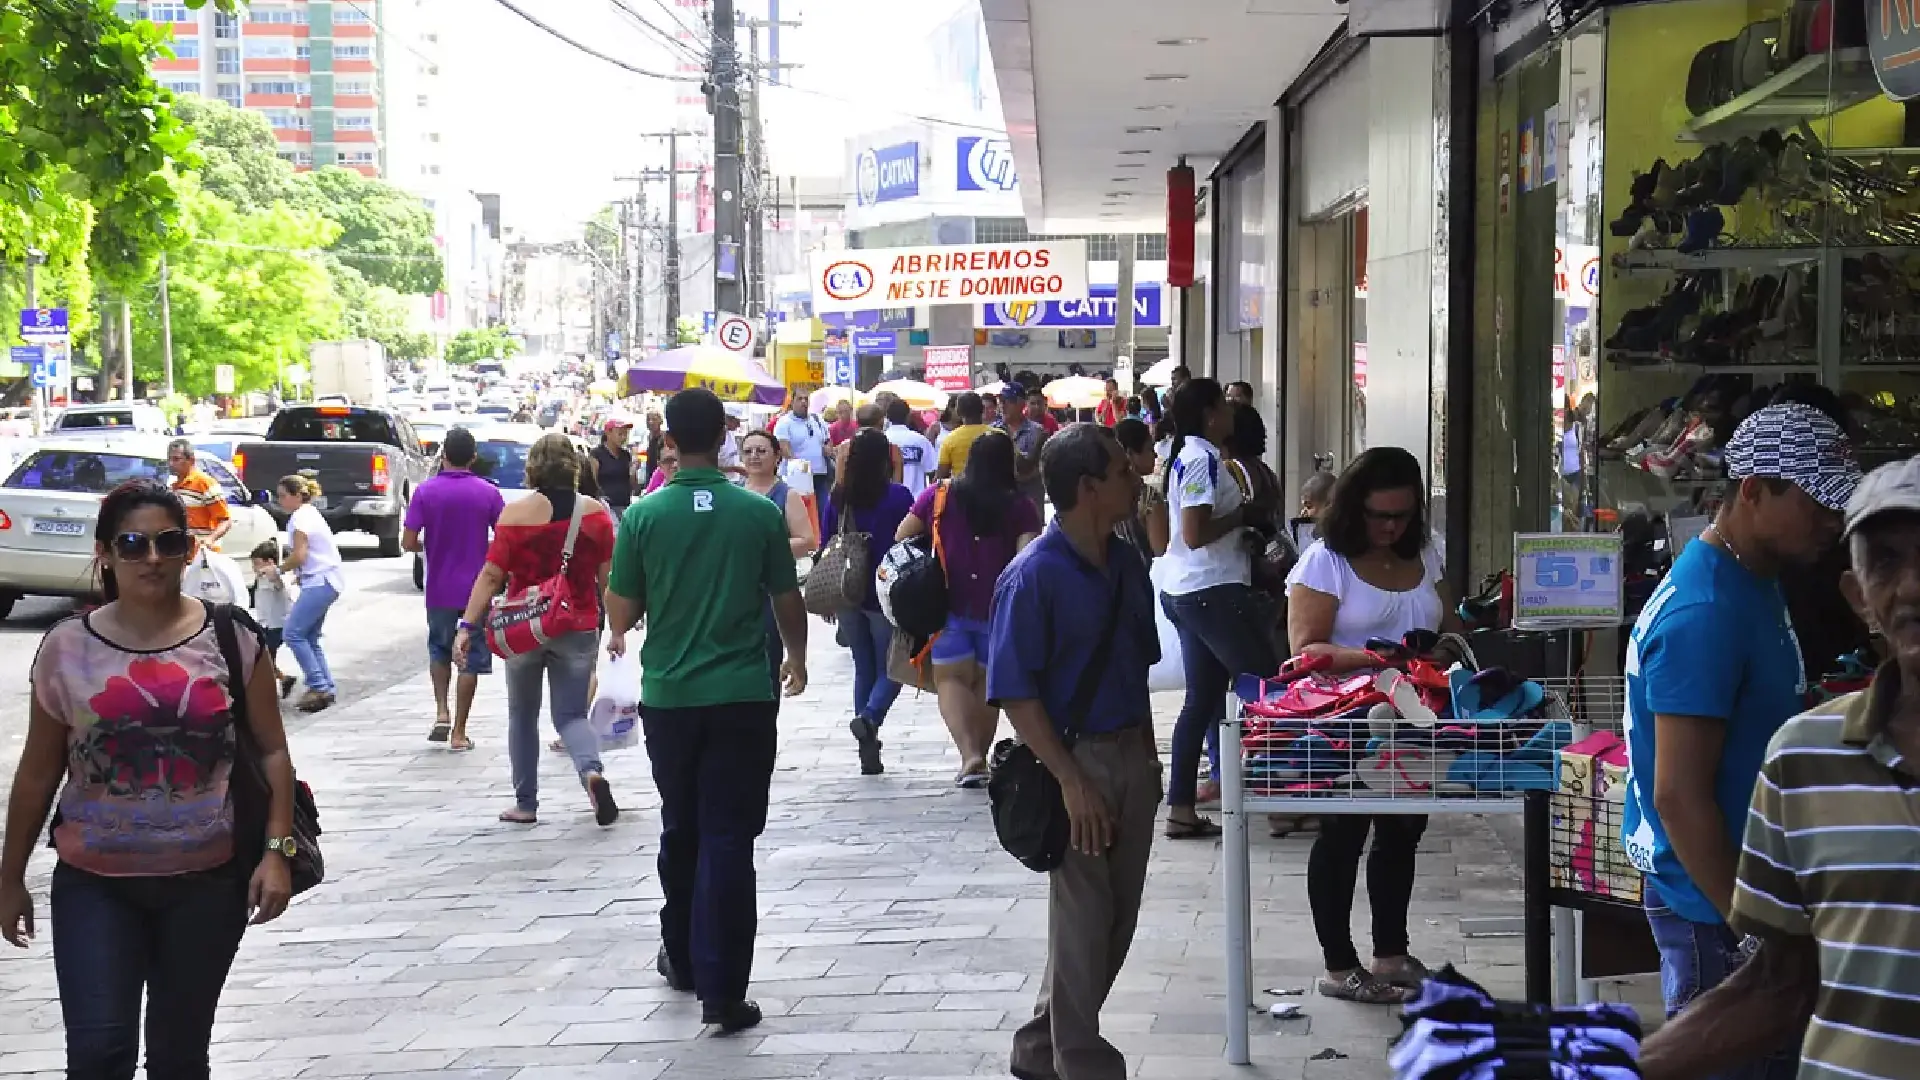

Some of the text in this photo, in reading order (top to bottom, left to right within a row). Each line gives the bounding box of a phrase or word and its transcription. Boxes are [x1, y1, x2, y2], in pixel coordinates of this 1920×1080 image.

[890, 249, 1050, 275] ABRIREMOS
[887, 274, 1064, 300] NESTE DOMINGO
[1059, 296, 1148, 318] CATTN
[729, 325, 743, 343] E
